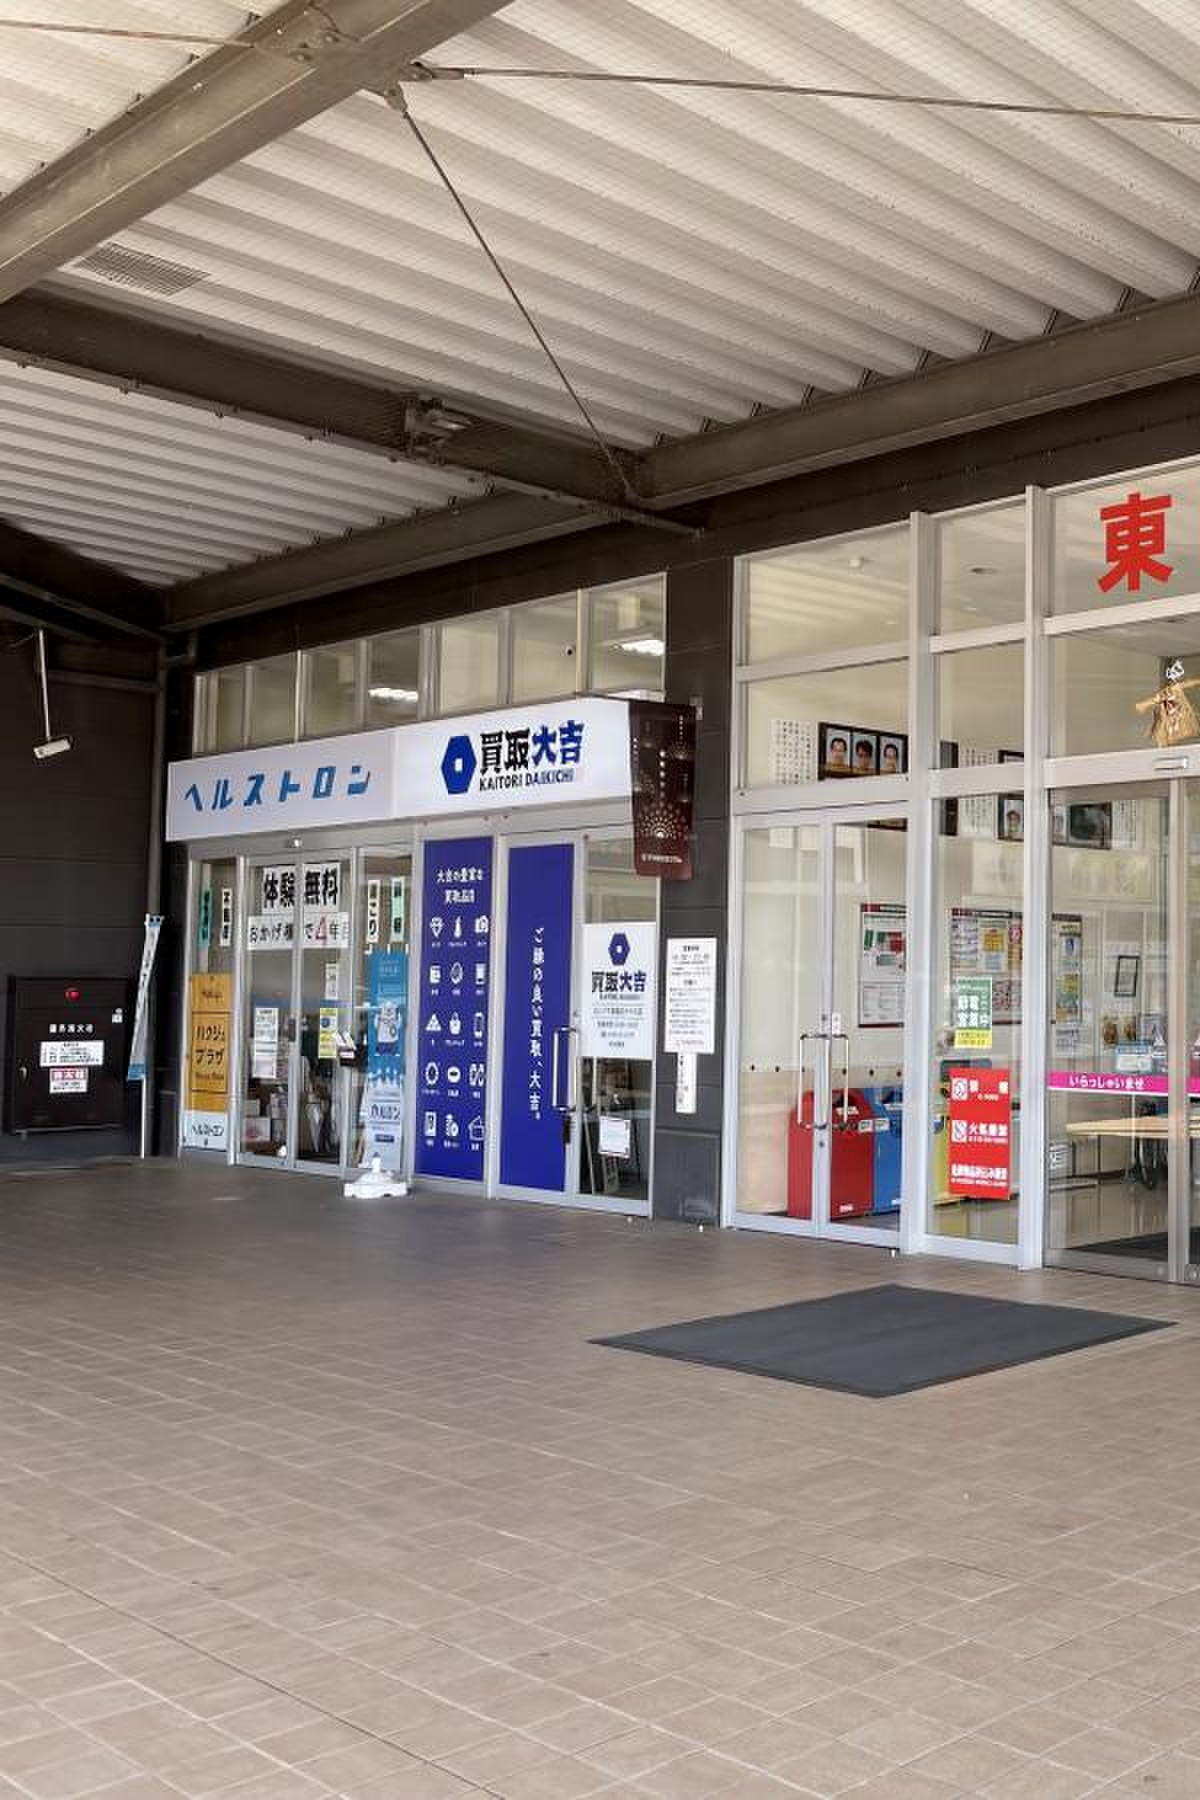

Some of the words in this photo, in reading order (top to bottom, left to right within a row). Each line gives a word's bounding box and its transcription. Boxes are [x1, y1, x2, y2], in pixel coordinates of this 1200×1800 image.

[480, 719, 585, 775] 買取大吉
[184, 766, 371, 811] ヘルストロン
[479, 773, 523, 791] KAITORI
[592, 970, 647, 992] 買取大吉
[1069, 1073, 1146, 1090] いらっしゃいませ
